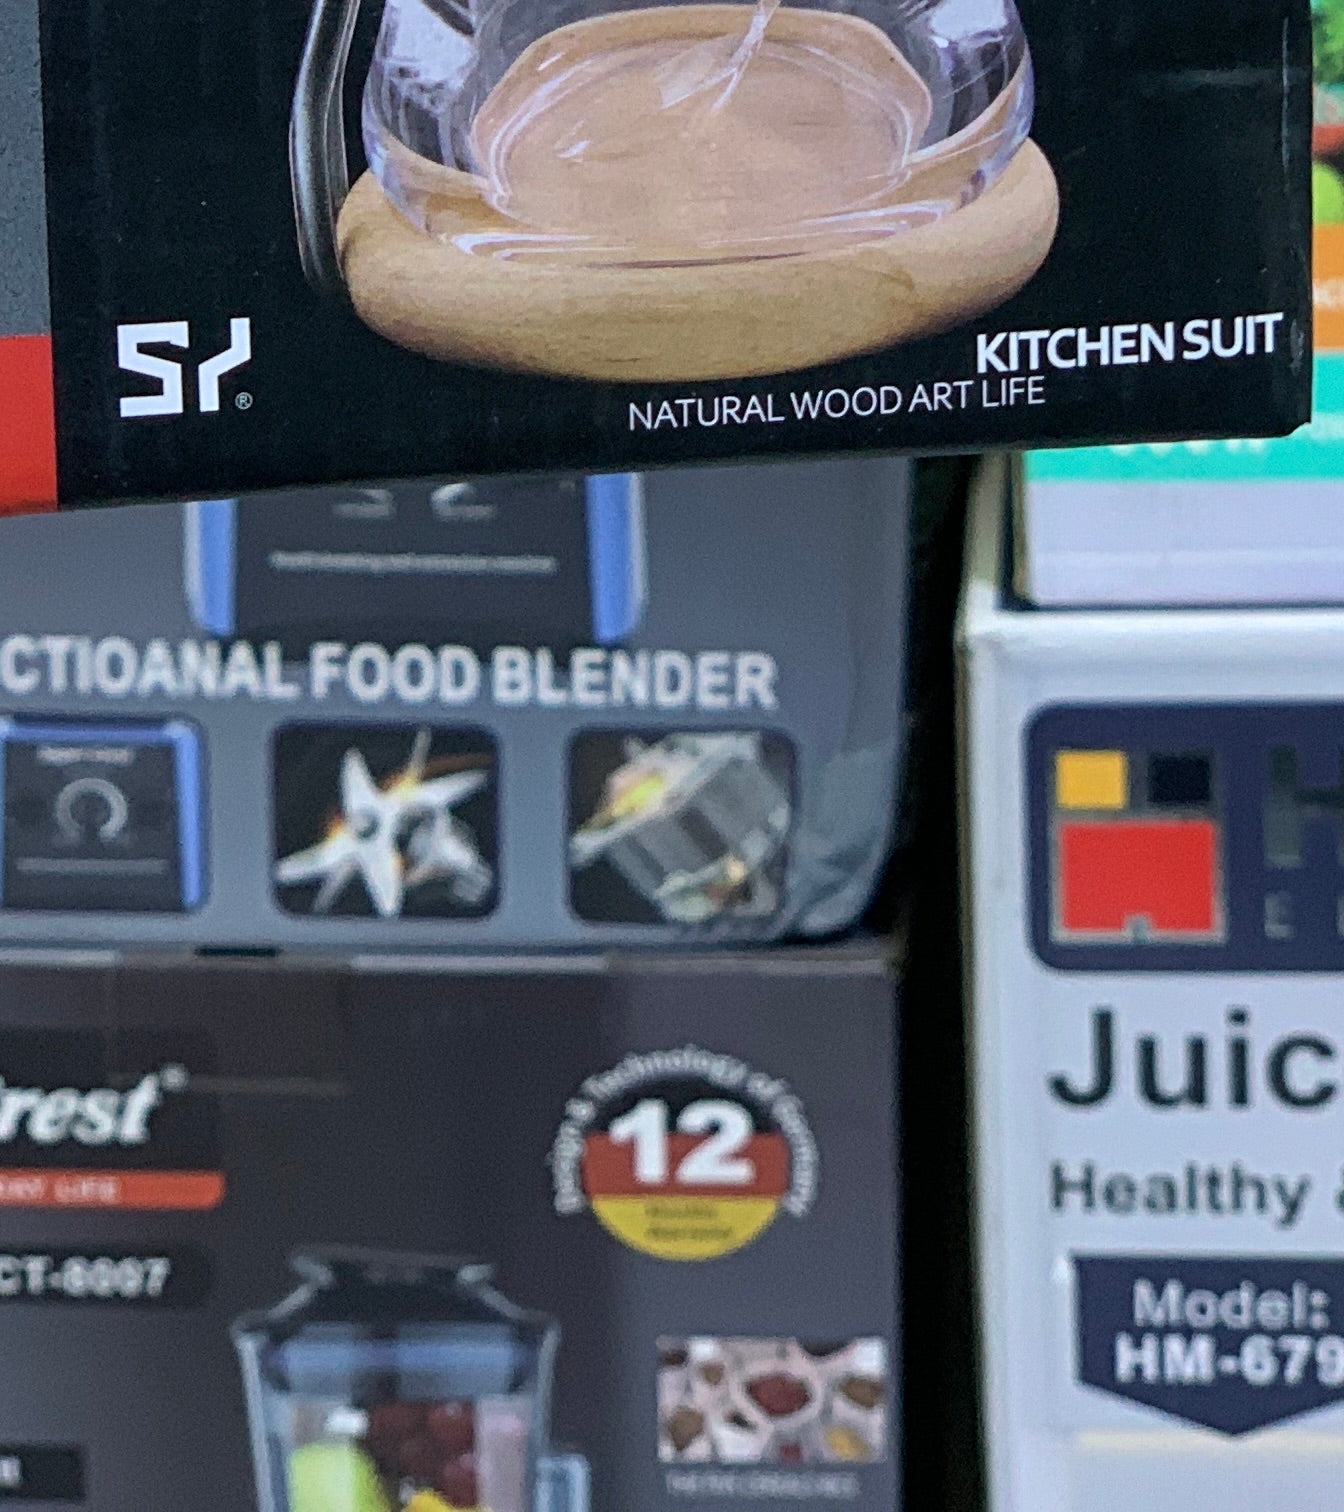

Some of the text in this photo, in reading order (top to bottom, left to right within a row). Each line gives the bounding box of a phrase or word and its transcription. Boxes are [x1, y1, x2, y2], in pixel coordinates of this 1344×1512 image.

[117, 317, 252, 418] SY
[975, 312, 1284, 375] KITCHEN SUIT
[629, 376, 1046, 431] NATURAL WOOD ART LIFE
[309, 641, 480, 706] FOOD
[491, 645, 778, 710] BLENDER
[609, 1096, 756, 1186] 12
[1049, 1160, 1311, 1230] Healthy
[1132, 1278, 1330, 1330] Model:
